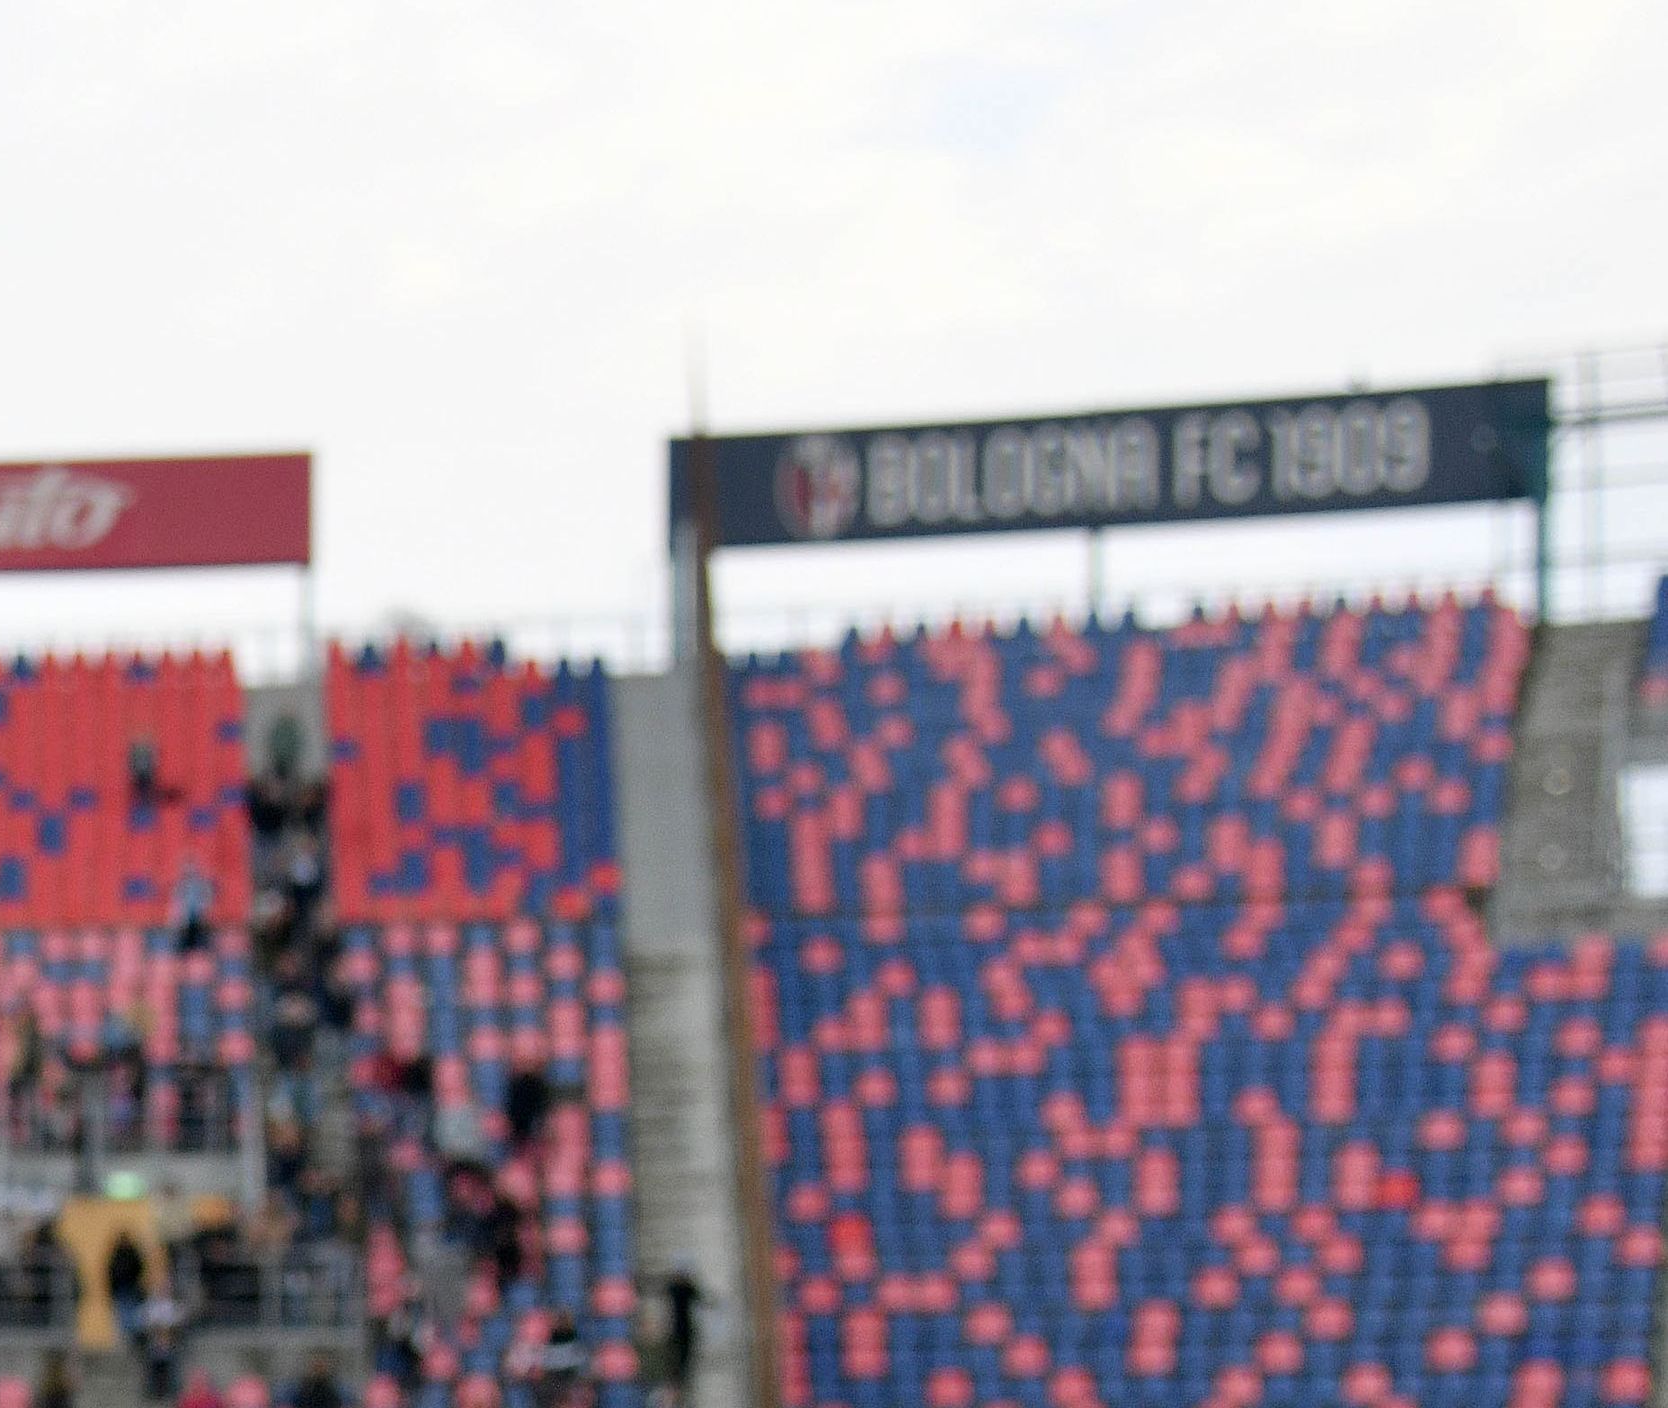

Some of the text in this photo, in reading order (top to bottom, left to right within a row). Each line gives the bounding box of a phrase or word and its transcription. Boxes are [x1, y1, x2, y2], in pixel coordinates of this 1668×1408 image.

[866, 400, 1432, 526] BOLOGNA FC 1909
